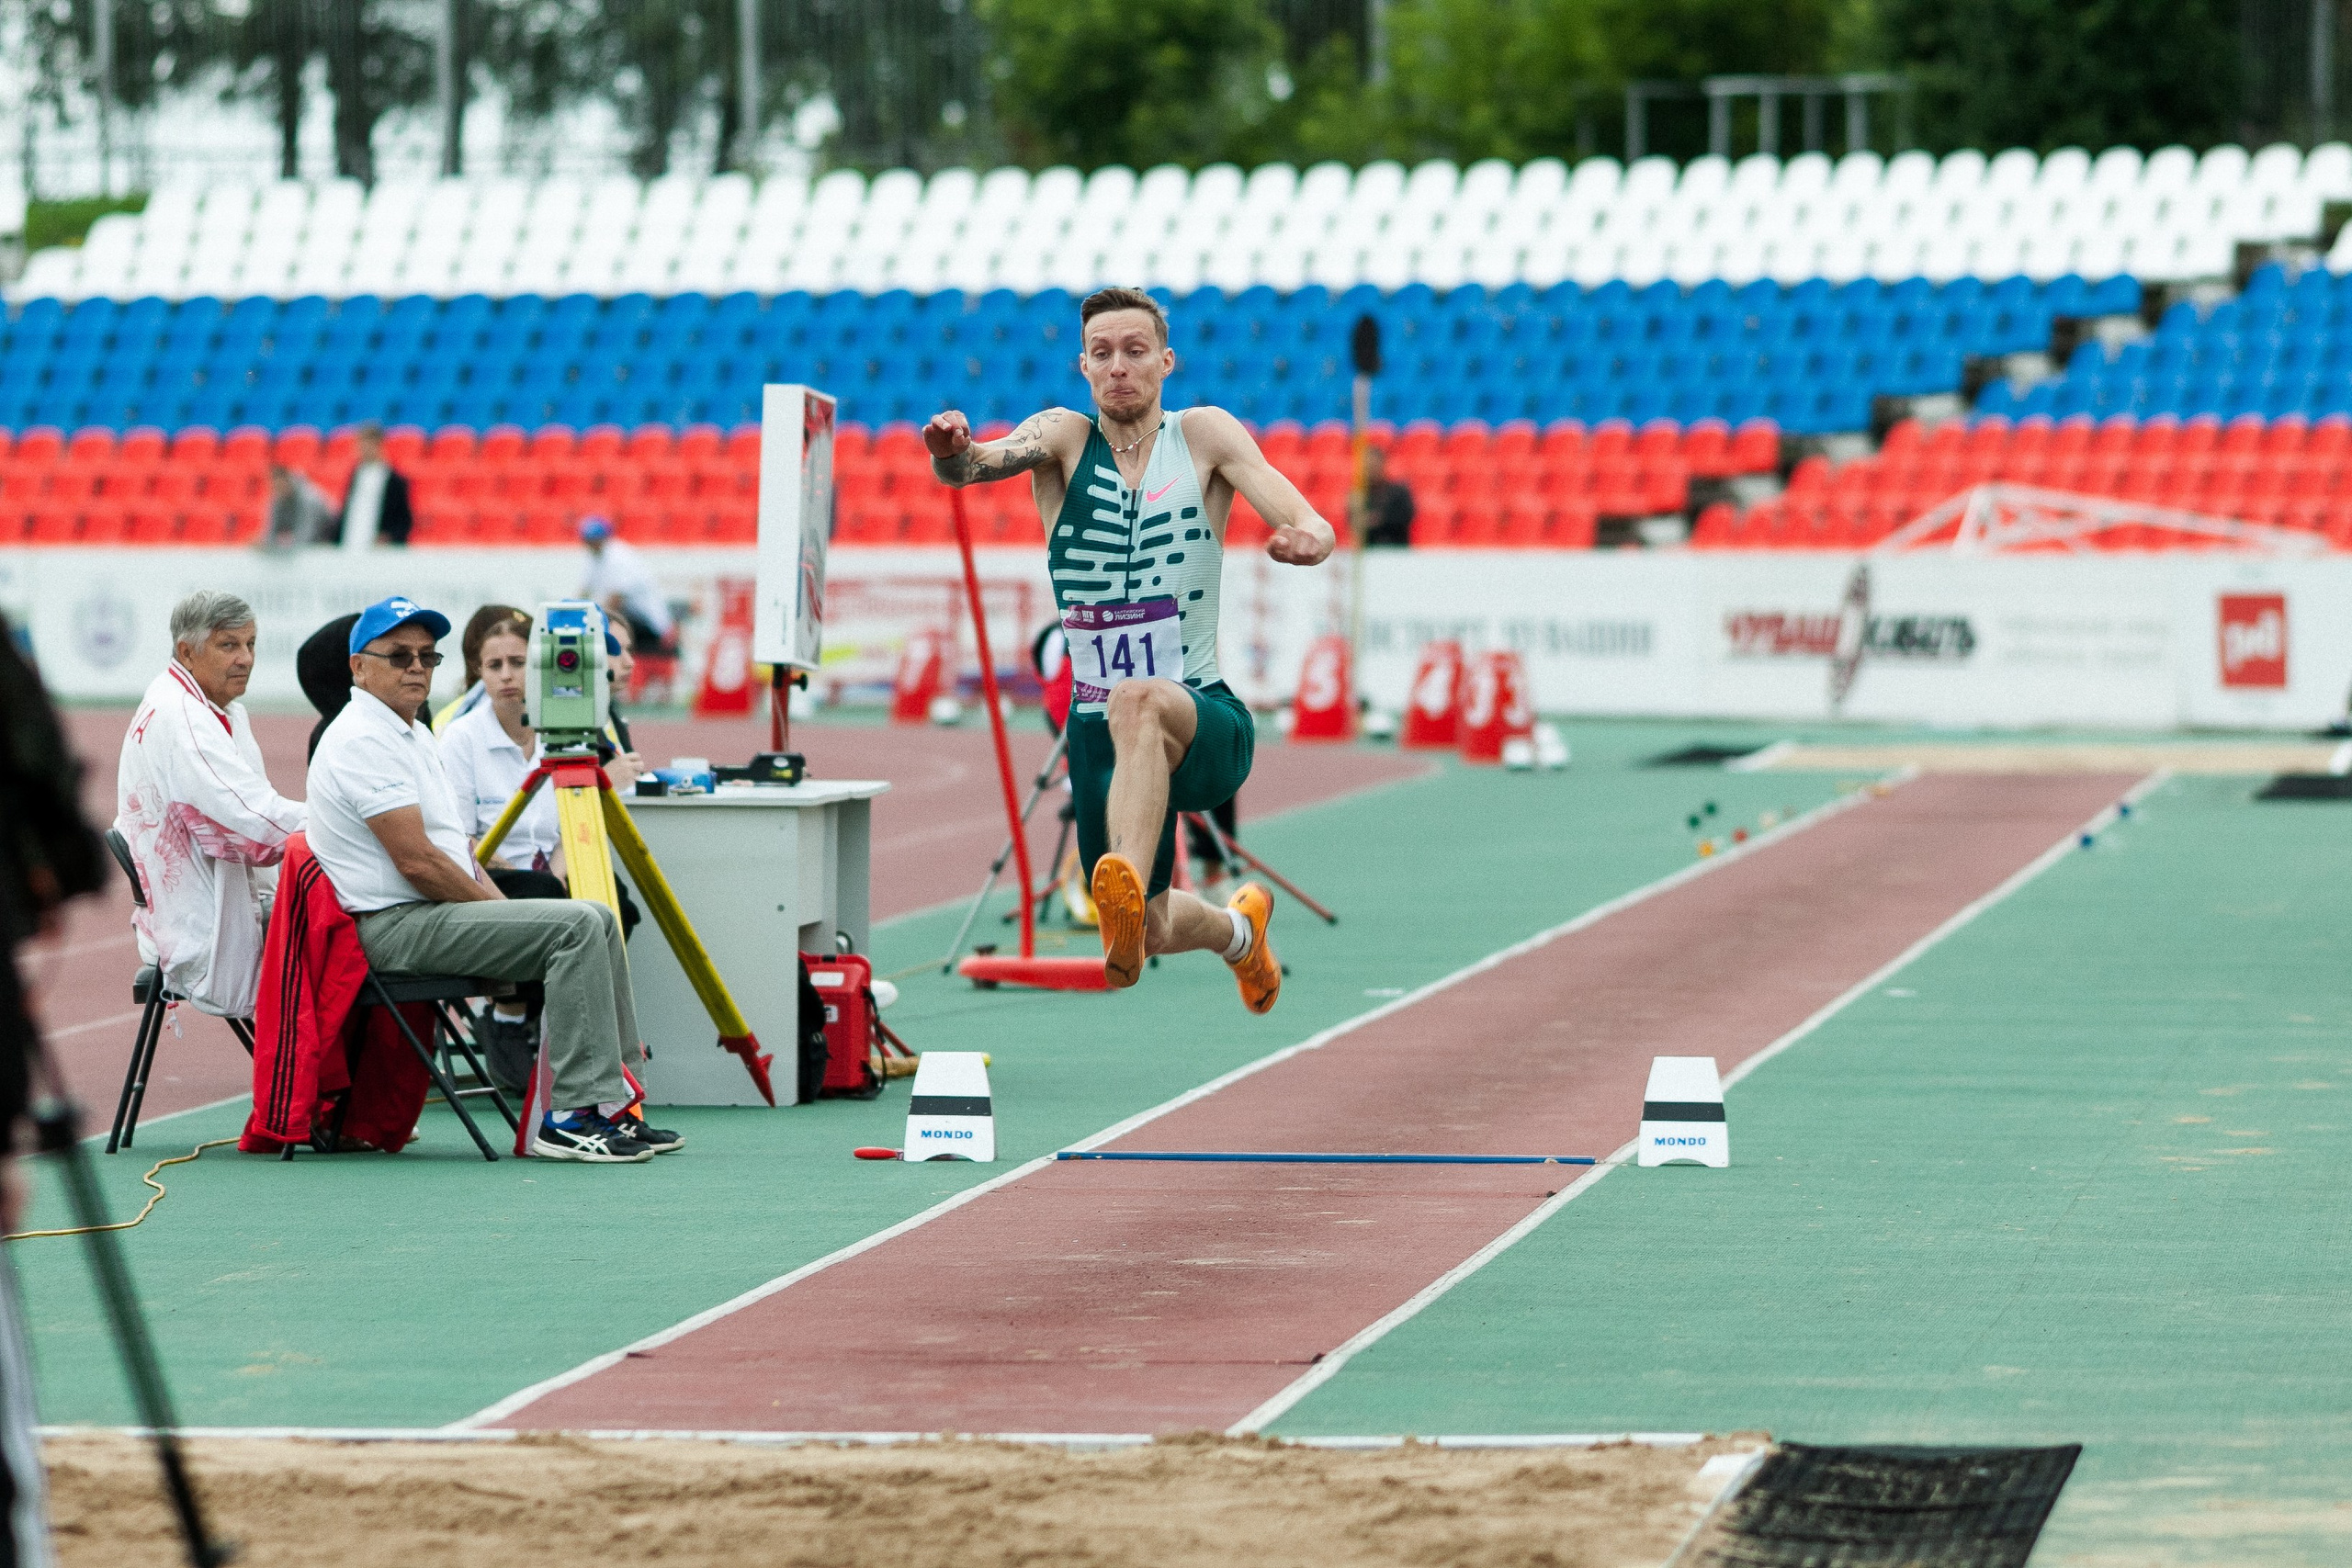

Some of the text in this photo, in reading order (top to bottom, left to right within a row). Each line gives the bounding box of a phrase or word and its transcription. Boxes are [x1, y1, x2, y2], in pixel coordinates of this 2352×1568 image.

[1114, 613, 1146, 621] ЛИЗИНГ
[1091, 632, 1156, 678] 141
[921, 1130, 974, 1139] MONDO
[1654, 1136, 1707, 1146] MONDO
